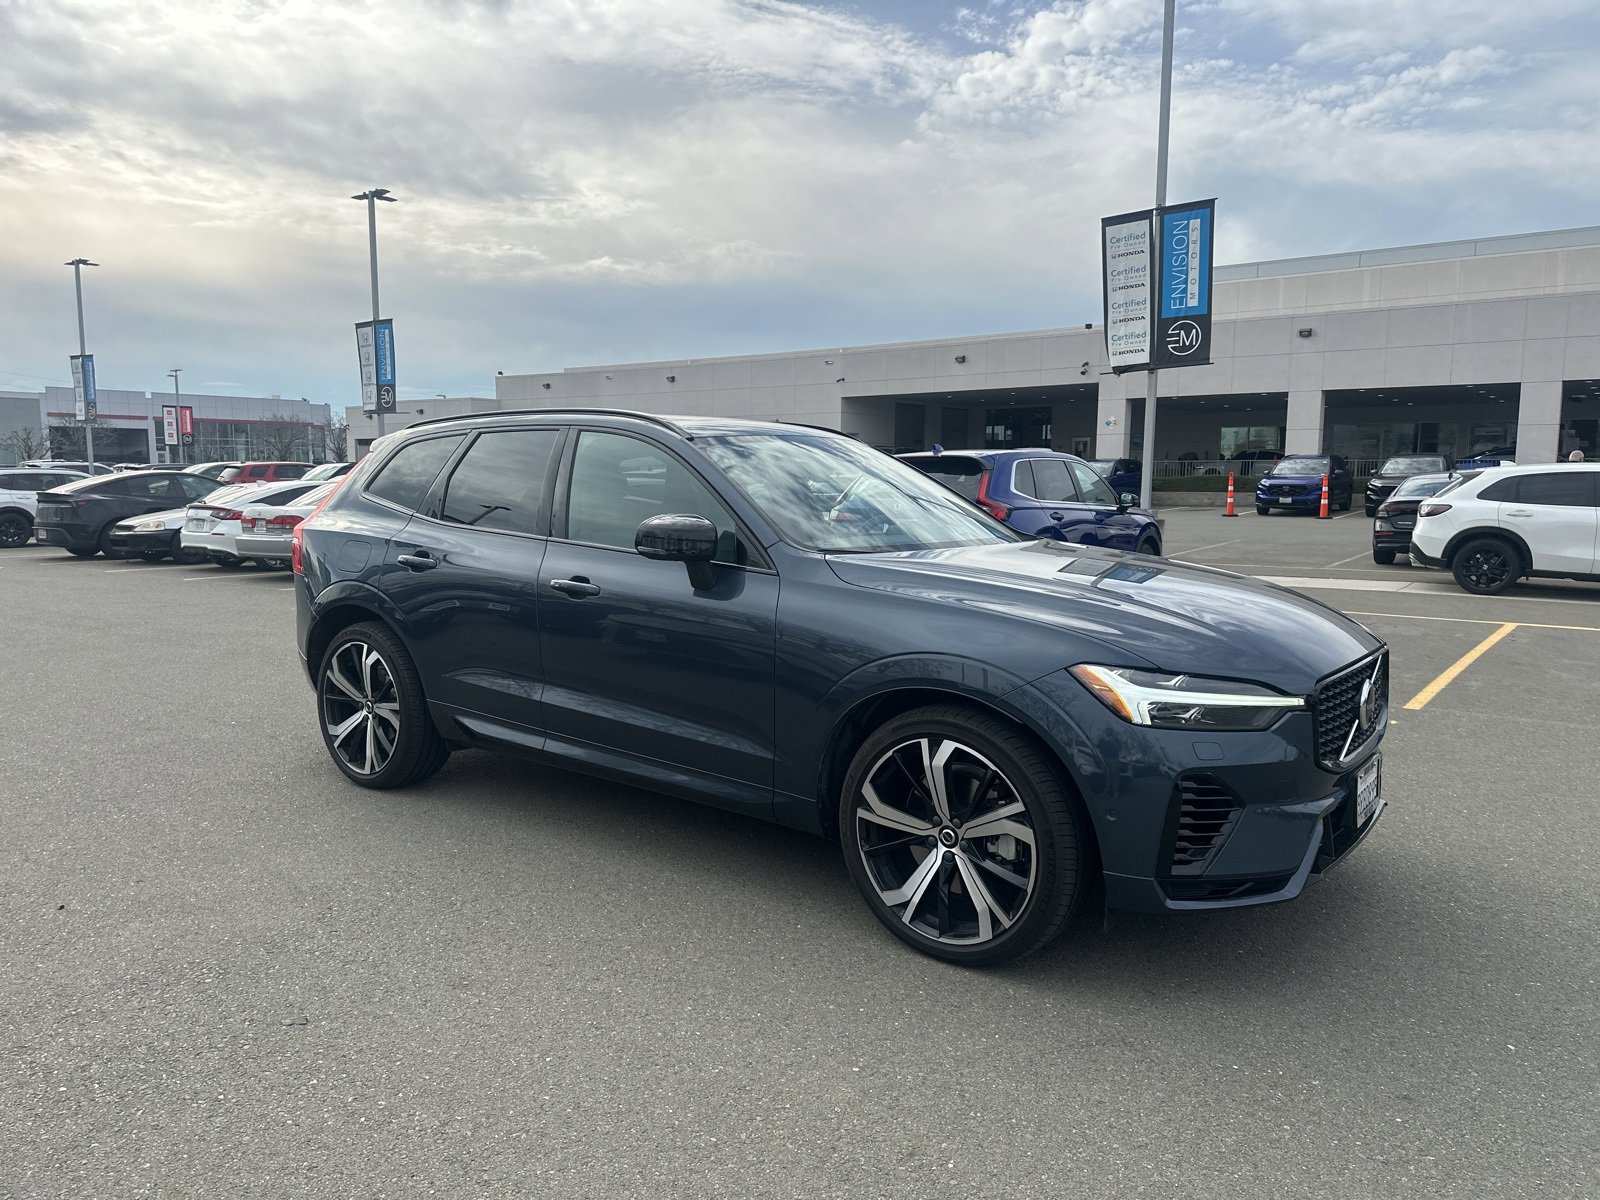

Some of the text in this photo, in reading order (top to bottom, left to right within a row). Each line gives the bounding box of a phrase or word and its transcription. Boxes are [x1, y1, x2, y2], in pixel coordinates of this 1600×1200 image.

[1110, 232, 1146, 244] Certified
[1124, 240, 1145, 248] Owned
[1118, 249, 1145, 258] HONDA
[1171, 221, 1188, 309] ENVISION
[1190, 228, 1199, 300] MOTORS
[1111, 265, 1146, 278] Certified
[1124, 273, 1146, 281] Owned
[1118, 283, 1146, 291] HONDA
[1112, 298, 1146, 310] Certified
[1125, 306, 1146, 314] Owned
[1112, 331, 1146, 342] Certified
[1119, 348, 1145, 356] HONDA
